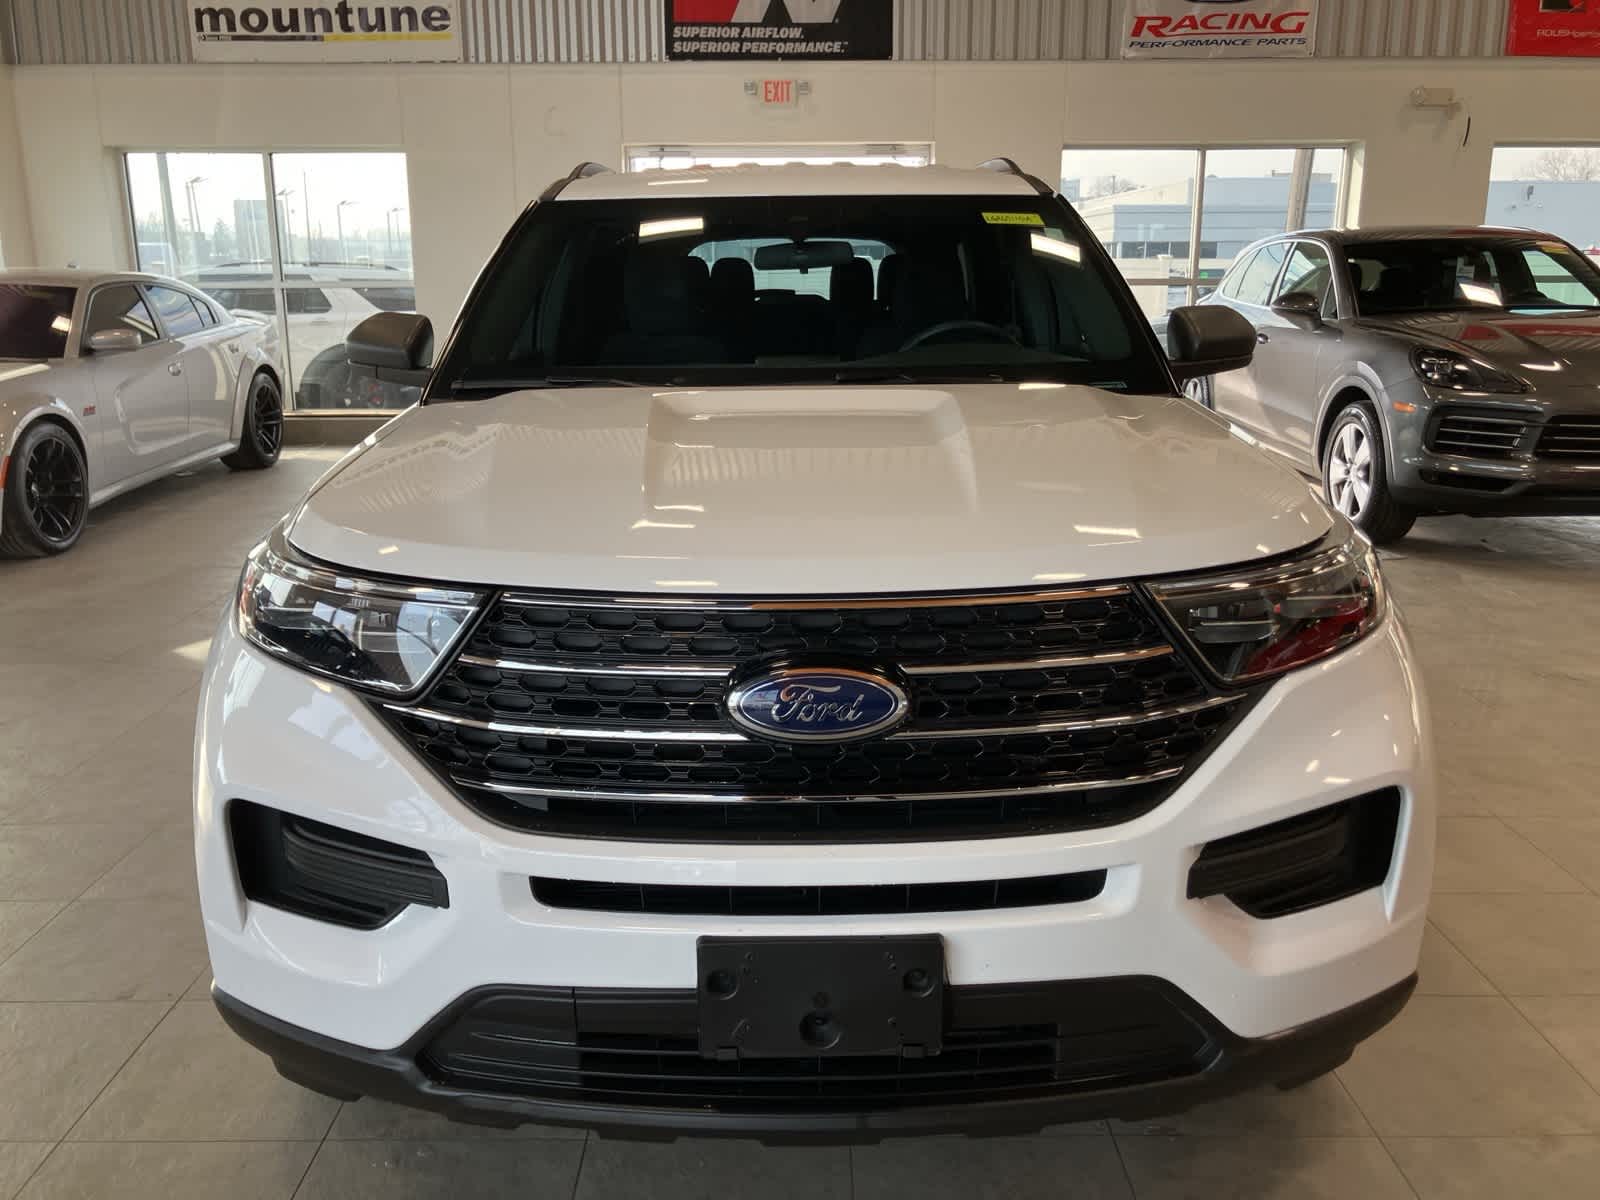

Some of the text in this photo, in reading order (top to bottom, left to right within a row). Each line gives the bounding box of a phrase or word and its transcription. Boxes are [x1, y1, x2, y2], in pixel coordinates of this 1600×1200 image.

[194, 0, 451, 33] mountune
[1131, 11, 1310, 37] RACING
[672, 26, 804, 39] SUPERIOR AIRFLOW.
[1128, 37, 1307, 49] PERFORMANCE PARTS
[672, 41, 740, 53] SUPERIOR
[763, 80, 792, 103] EXIT
[771, 684, 865, 723] Ford
